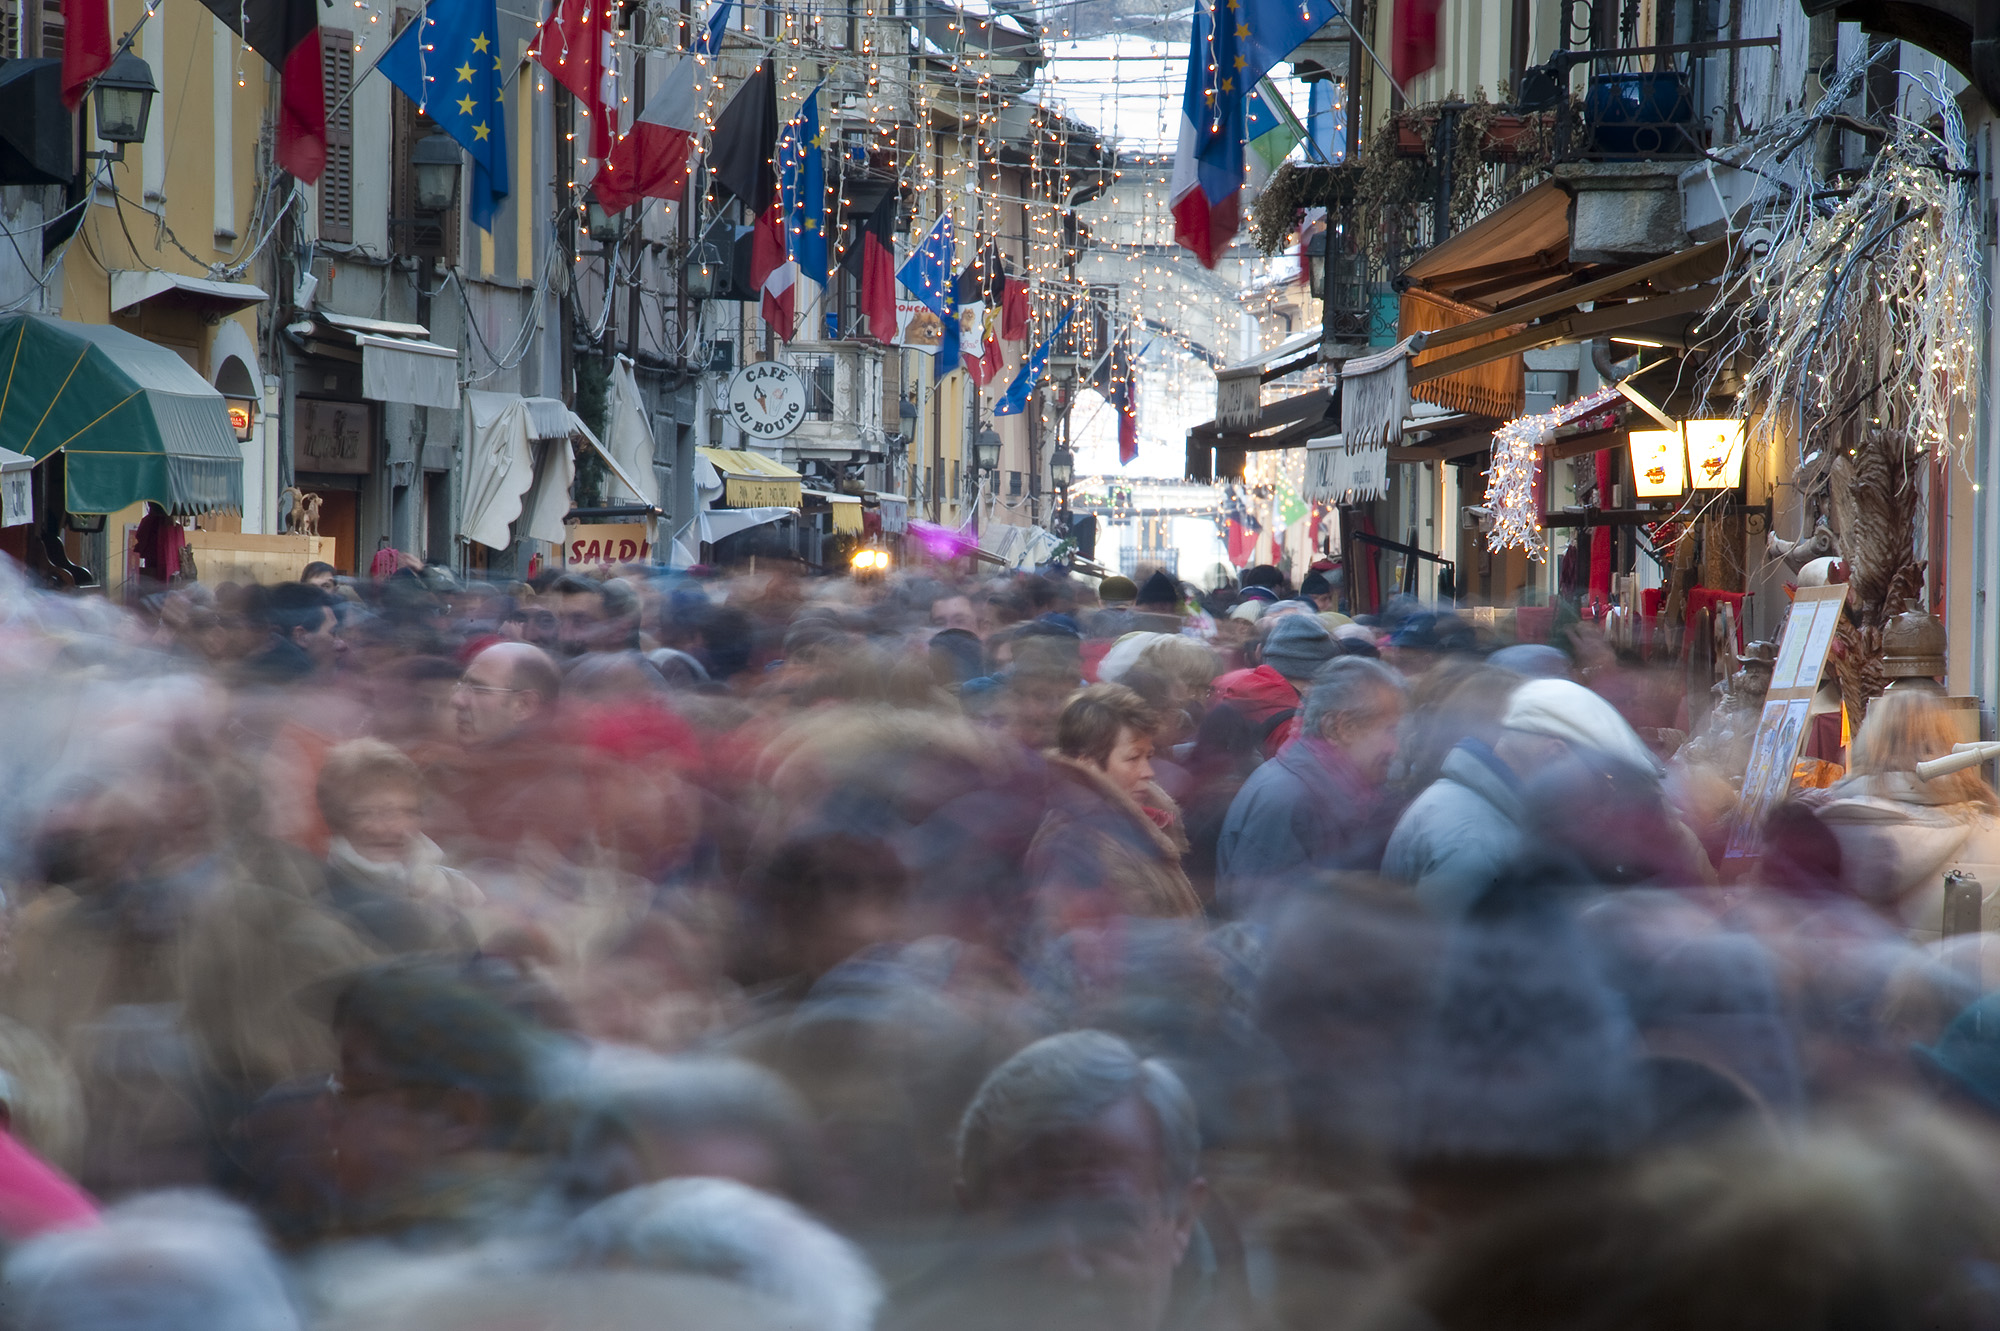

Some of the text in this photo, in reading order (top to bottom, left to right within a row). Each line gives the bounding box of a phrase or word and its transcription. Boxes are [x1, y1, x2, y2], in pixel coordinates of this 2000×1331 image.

[734, 402, 800, 434] DU BOURG
[568, 539, 649, 565] SALDI
